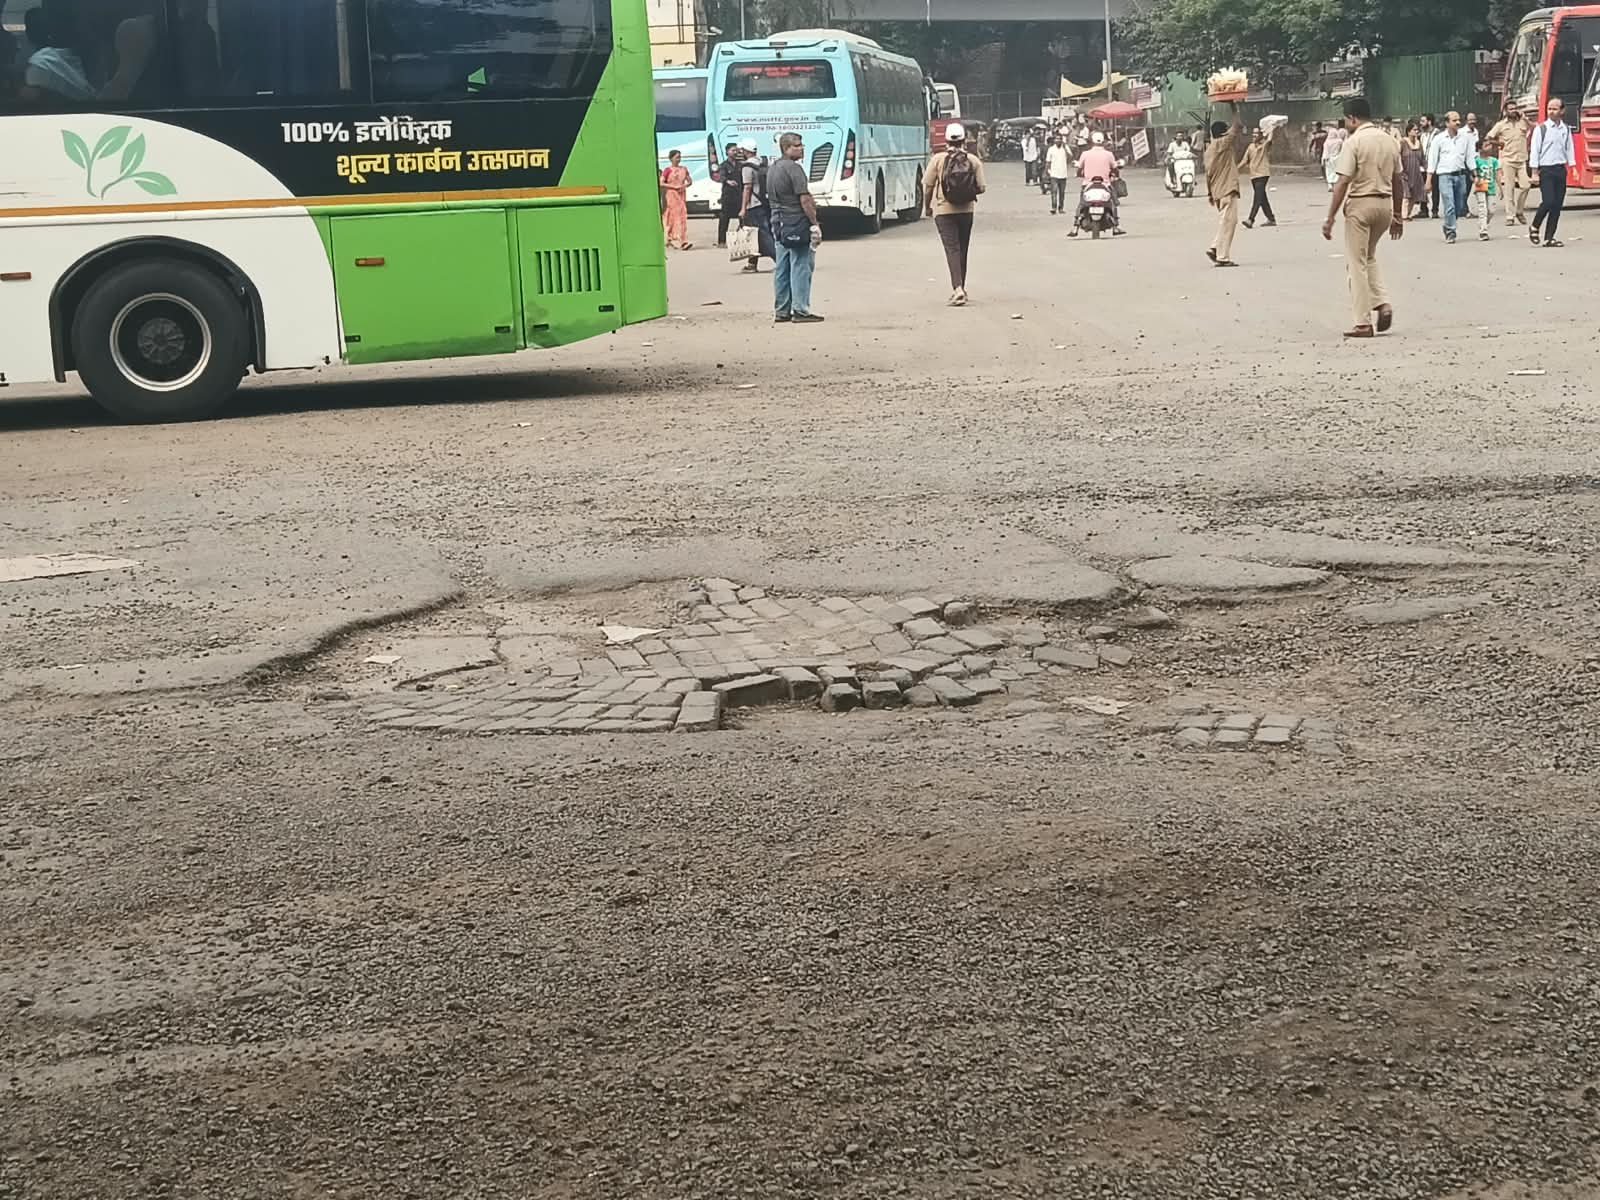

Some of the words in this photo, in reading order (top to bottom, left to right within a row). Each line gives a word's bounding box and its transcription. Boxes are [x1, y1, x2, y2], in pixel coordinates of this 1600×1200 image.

[281, 122, 350, 143] 100%
[336, 153, 391, 184] शून्य
[395, 147, 462, 174] कार्बन
